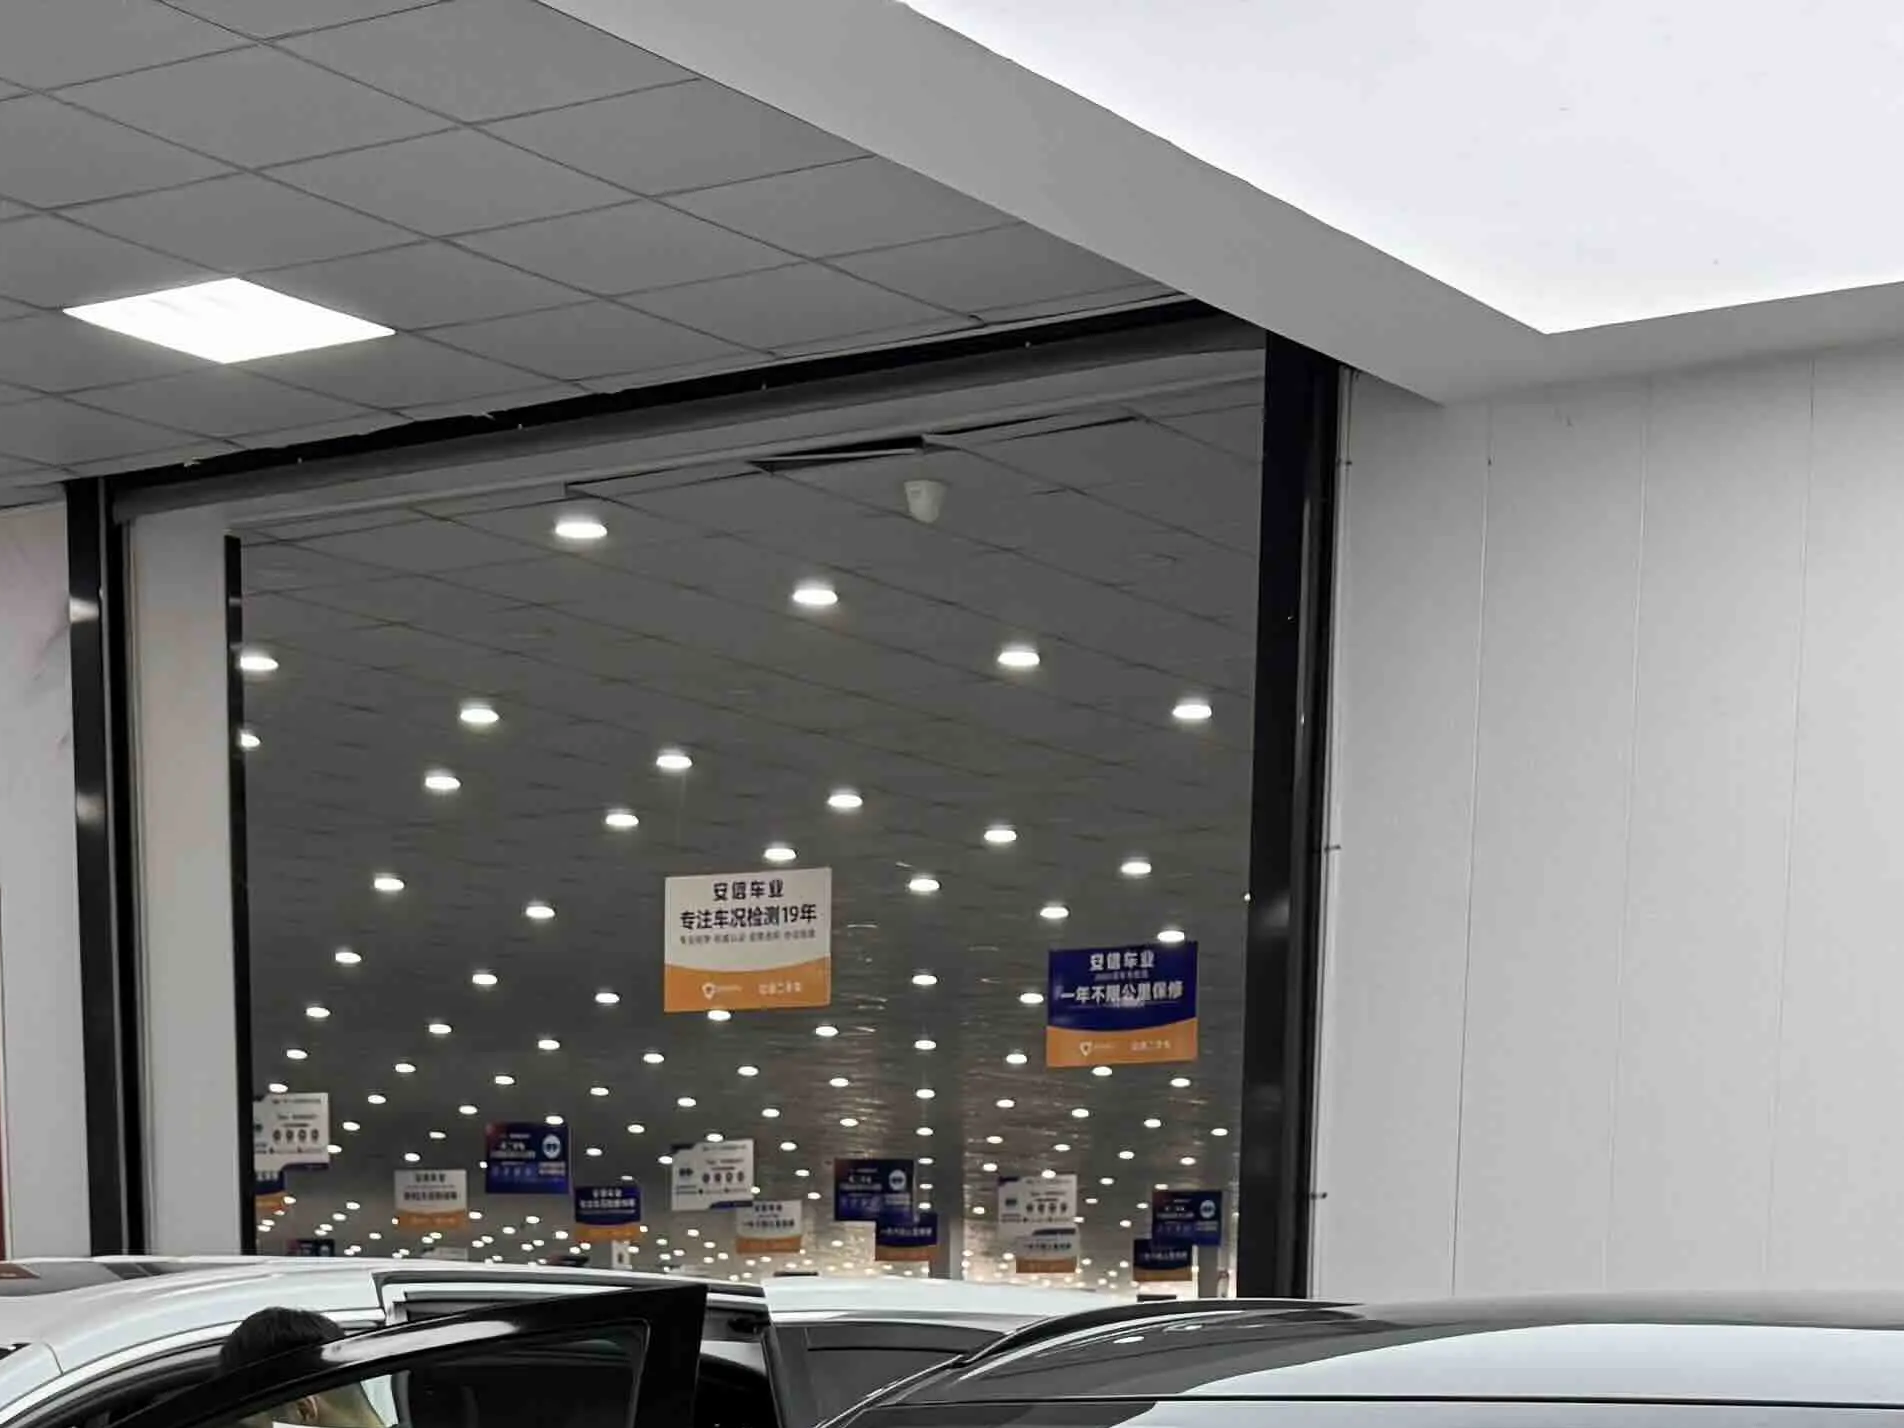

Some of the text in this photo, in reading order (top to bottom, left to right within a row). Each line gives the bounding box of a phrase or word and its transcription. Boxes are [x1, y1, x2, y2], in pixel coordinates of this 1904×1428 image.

[712, 879, 785, 902] 安信车业
[679, 903, 818, 930] 专注车况检测19年
[1089, 950, 1155, 972] 安信车业
